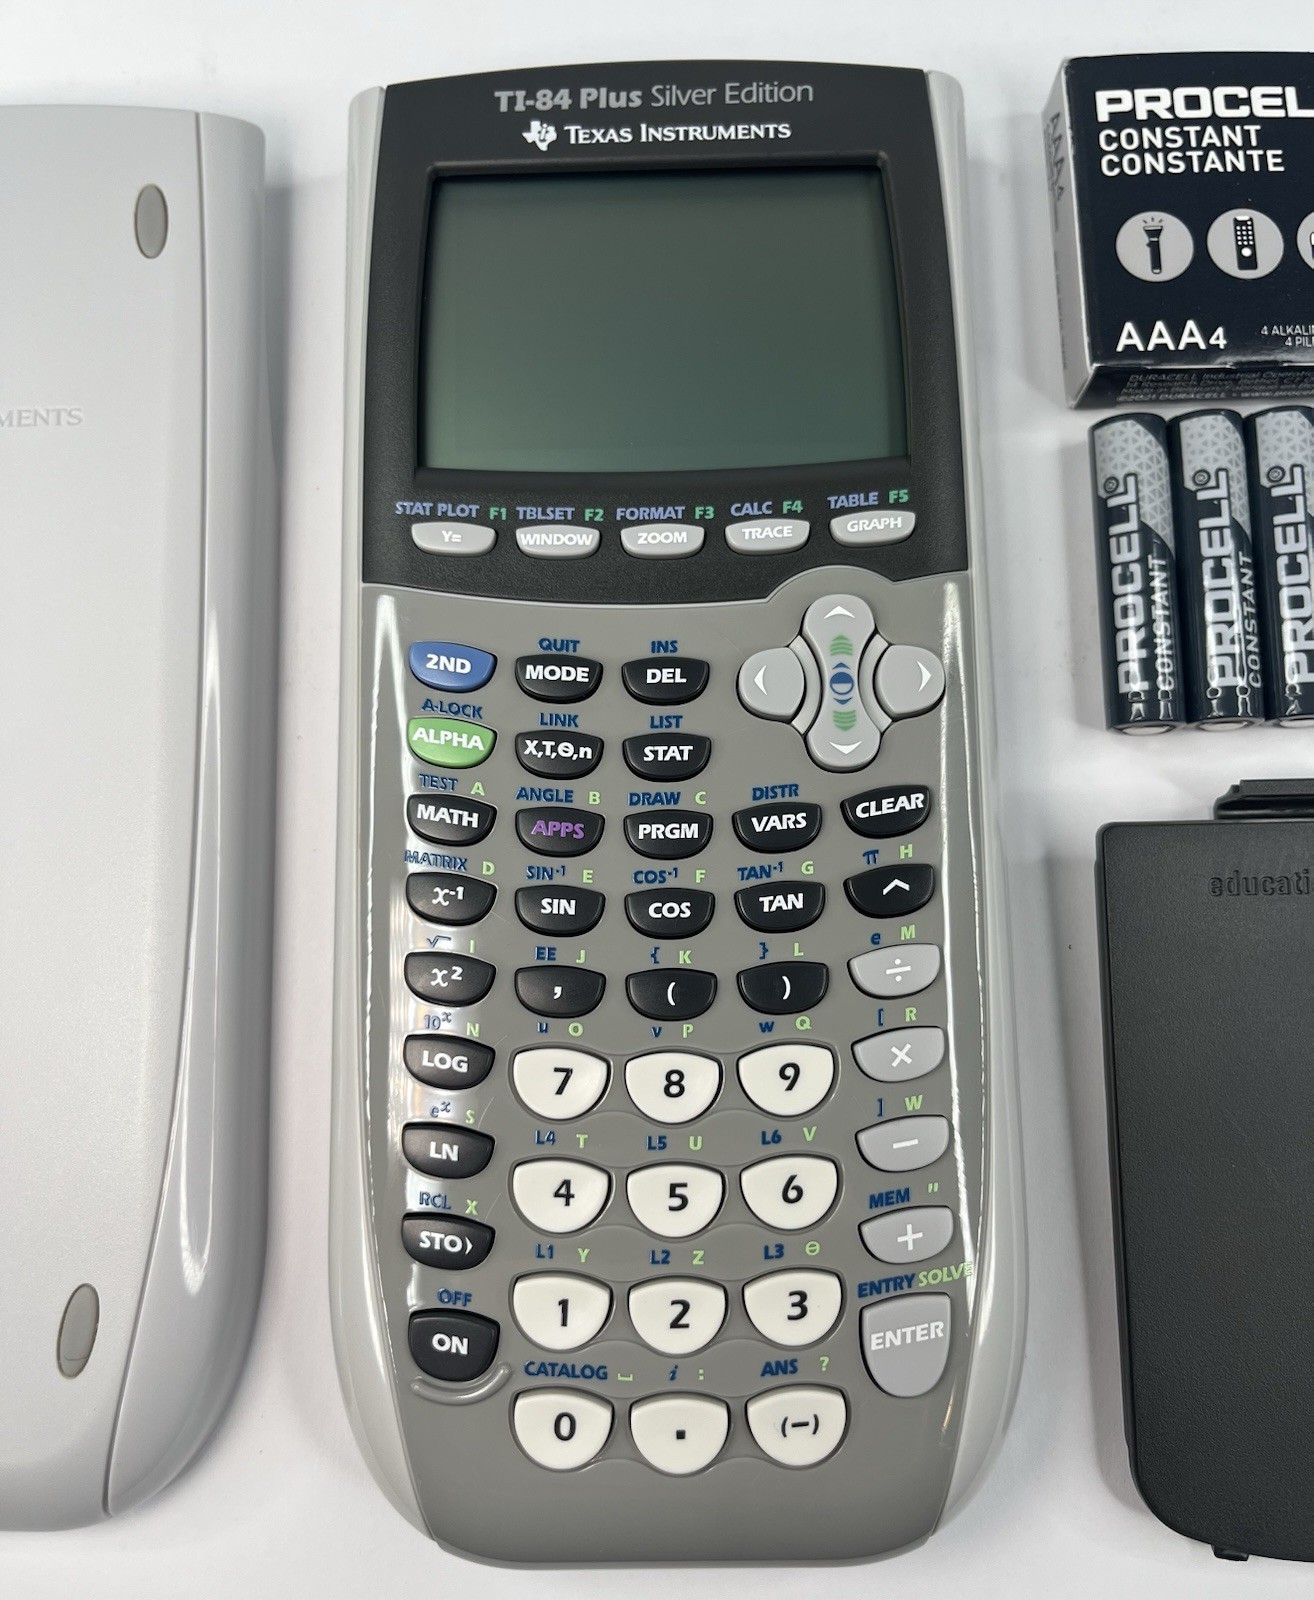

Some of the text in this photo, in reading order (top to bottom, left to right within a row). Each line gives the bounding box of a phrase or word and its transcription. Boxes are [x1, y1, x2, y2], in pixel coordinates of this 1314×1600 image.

[494, 81, 814, 112] TI-84 Plus Silver Edition
[564, 122, 792, 145] TEXAS INSTRUMENTS
[1099, 125, 1261, 152] CONSTANT
[1100, 149, 1286, 177] CONSTANTE
[1260, 324, 1314, 337] 4 ALKALI
[1285, 337, 1314, 349] 4 PIL
[730, 500, 803, 517] CALC F4
[827, 490, 909, 509] TABLE F5
[395, 501, 507, 520] STAT PLOT F1
[516, 507, 604, 522] TBLSET F2
[616, 506, 714, 521] FORMAT F3
[742, 526, 793, 540] TRACE
[846, 517, 902, 533] GRAPH
[442, 531, 462, 543] Y=
[520, 533, 593, 546] WINDOW
[637, 532, 688, 545] ZOOM
[1107, 473, 1149, 694] PROCELL
[1196, 468, 1240, 688] PROCELL
[1271, 464, 1314, 684] PROCELL
[1148, 554, 1175, 691] CONSTANT
[1238, 551, 1263, 689] CONSTANT
[537, 638, 580, 653] QUIT
[650, 640, 678, 654] INS
[425, 654, 472, 675] 2ND
[525, 664, 590, 683] MODE
[646, 668, 687, 684] DEL
[421, 699, 483, 719] A-LOCK
[539, 712, 579, 728] LINK
[650, 715, 683, 729] LIST
[412, 727, 485, 751] ALPHA
[643, 746, 693, 761] STAT
[419, 773, 485, 796] TEST A
[752, 783, 800, 801] DISTR
[516, 786, 601, 805] ANGLE B
[627, 791, 706, 806] DRAW C
[416, 803, 479, 828] MATH
[855, 793, 925, 819] CLEAR
[531, 820, 585, 839] APPS
[638, 823, 699, 840] PRGM
[751, 813, 807, 833] VARS
[900, 844, 913, 859] H
[404, 850, 496, 875] MATRIX D
[801, 860, 814, 875] G
[582, 870, 593, 883] E
[696, 869, 706, 884] F
[1209, 869, 1311, 897] educati
[541, 898, 576, 915] SIN
[648, 901, 692, 919] COS
[759, 893, 804, 913] TAN
[870, 925, 916, 945] e M
[535, 947, 586, 964] EE J
[679, 950, 692, 965] K
[794, 943, 803, 957] L
[795, 1016, 812, 1031] Q
[905, 1007, 917, 1022] R
[466, 1022, 480, 1038] N
[537, 1022, 548, 1034] u
[682, 1024, 694, 1039] P
[422, 1050, 468, 1073] LOG
[553, 1067, 573, 1095] 7
[663, 1069, 686, 1098] 8
[778, 1062, 801, 1092] 9
[904, 1095, 924, 1111] W
[466, 1109, 475, 1124] S
[535, 1130, 588, 1149] L4 T
[647, 1136, 703, 1151] L5 U
[761, 1126, 817, 1146] L6 V
[429, 1141, 459, 1162] LN
[553, 1179, 575, 1207] 4
[668, 1182, 689, 1212] 5
[782, 1174, 804, 1204] 6
[419, 1190, 478, 1216] RCL X
[869, 1188, 911, 1210] MEM
[535, 1243, 590, 1263] L1 Y
[649, 1250, 705, 1265] L2 Z
[763, 1243, 784, 1260] L3
[857, 1261, 974, 1298] ENTRY SOLVE
[437, 1287, 472, 1307] OFF
[787, 1290, 809, 1321] 3
[558, 1299, 569, 1327] 1
[669, 1299, 691, 1330] 2
[431, 1333, 469, 1355] ON
[870, 1320, 945, 1351] ENTER
[524, 1360, 608, 1380] CATALOG
[669, 1364, 679, 1381] i
[760, 1356, 830, 1378] ANS ?
[554, 1412, 577, 1441] 0
